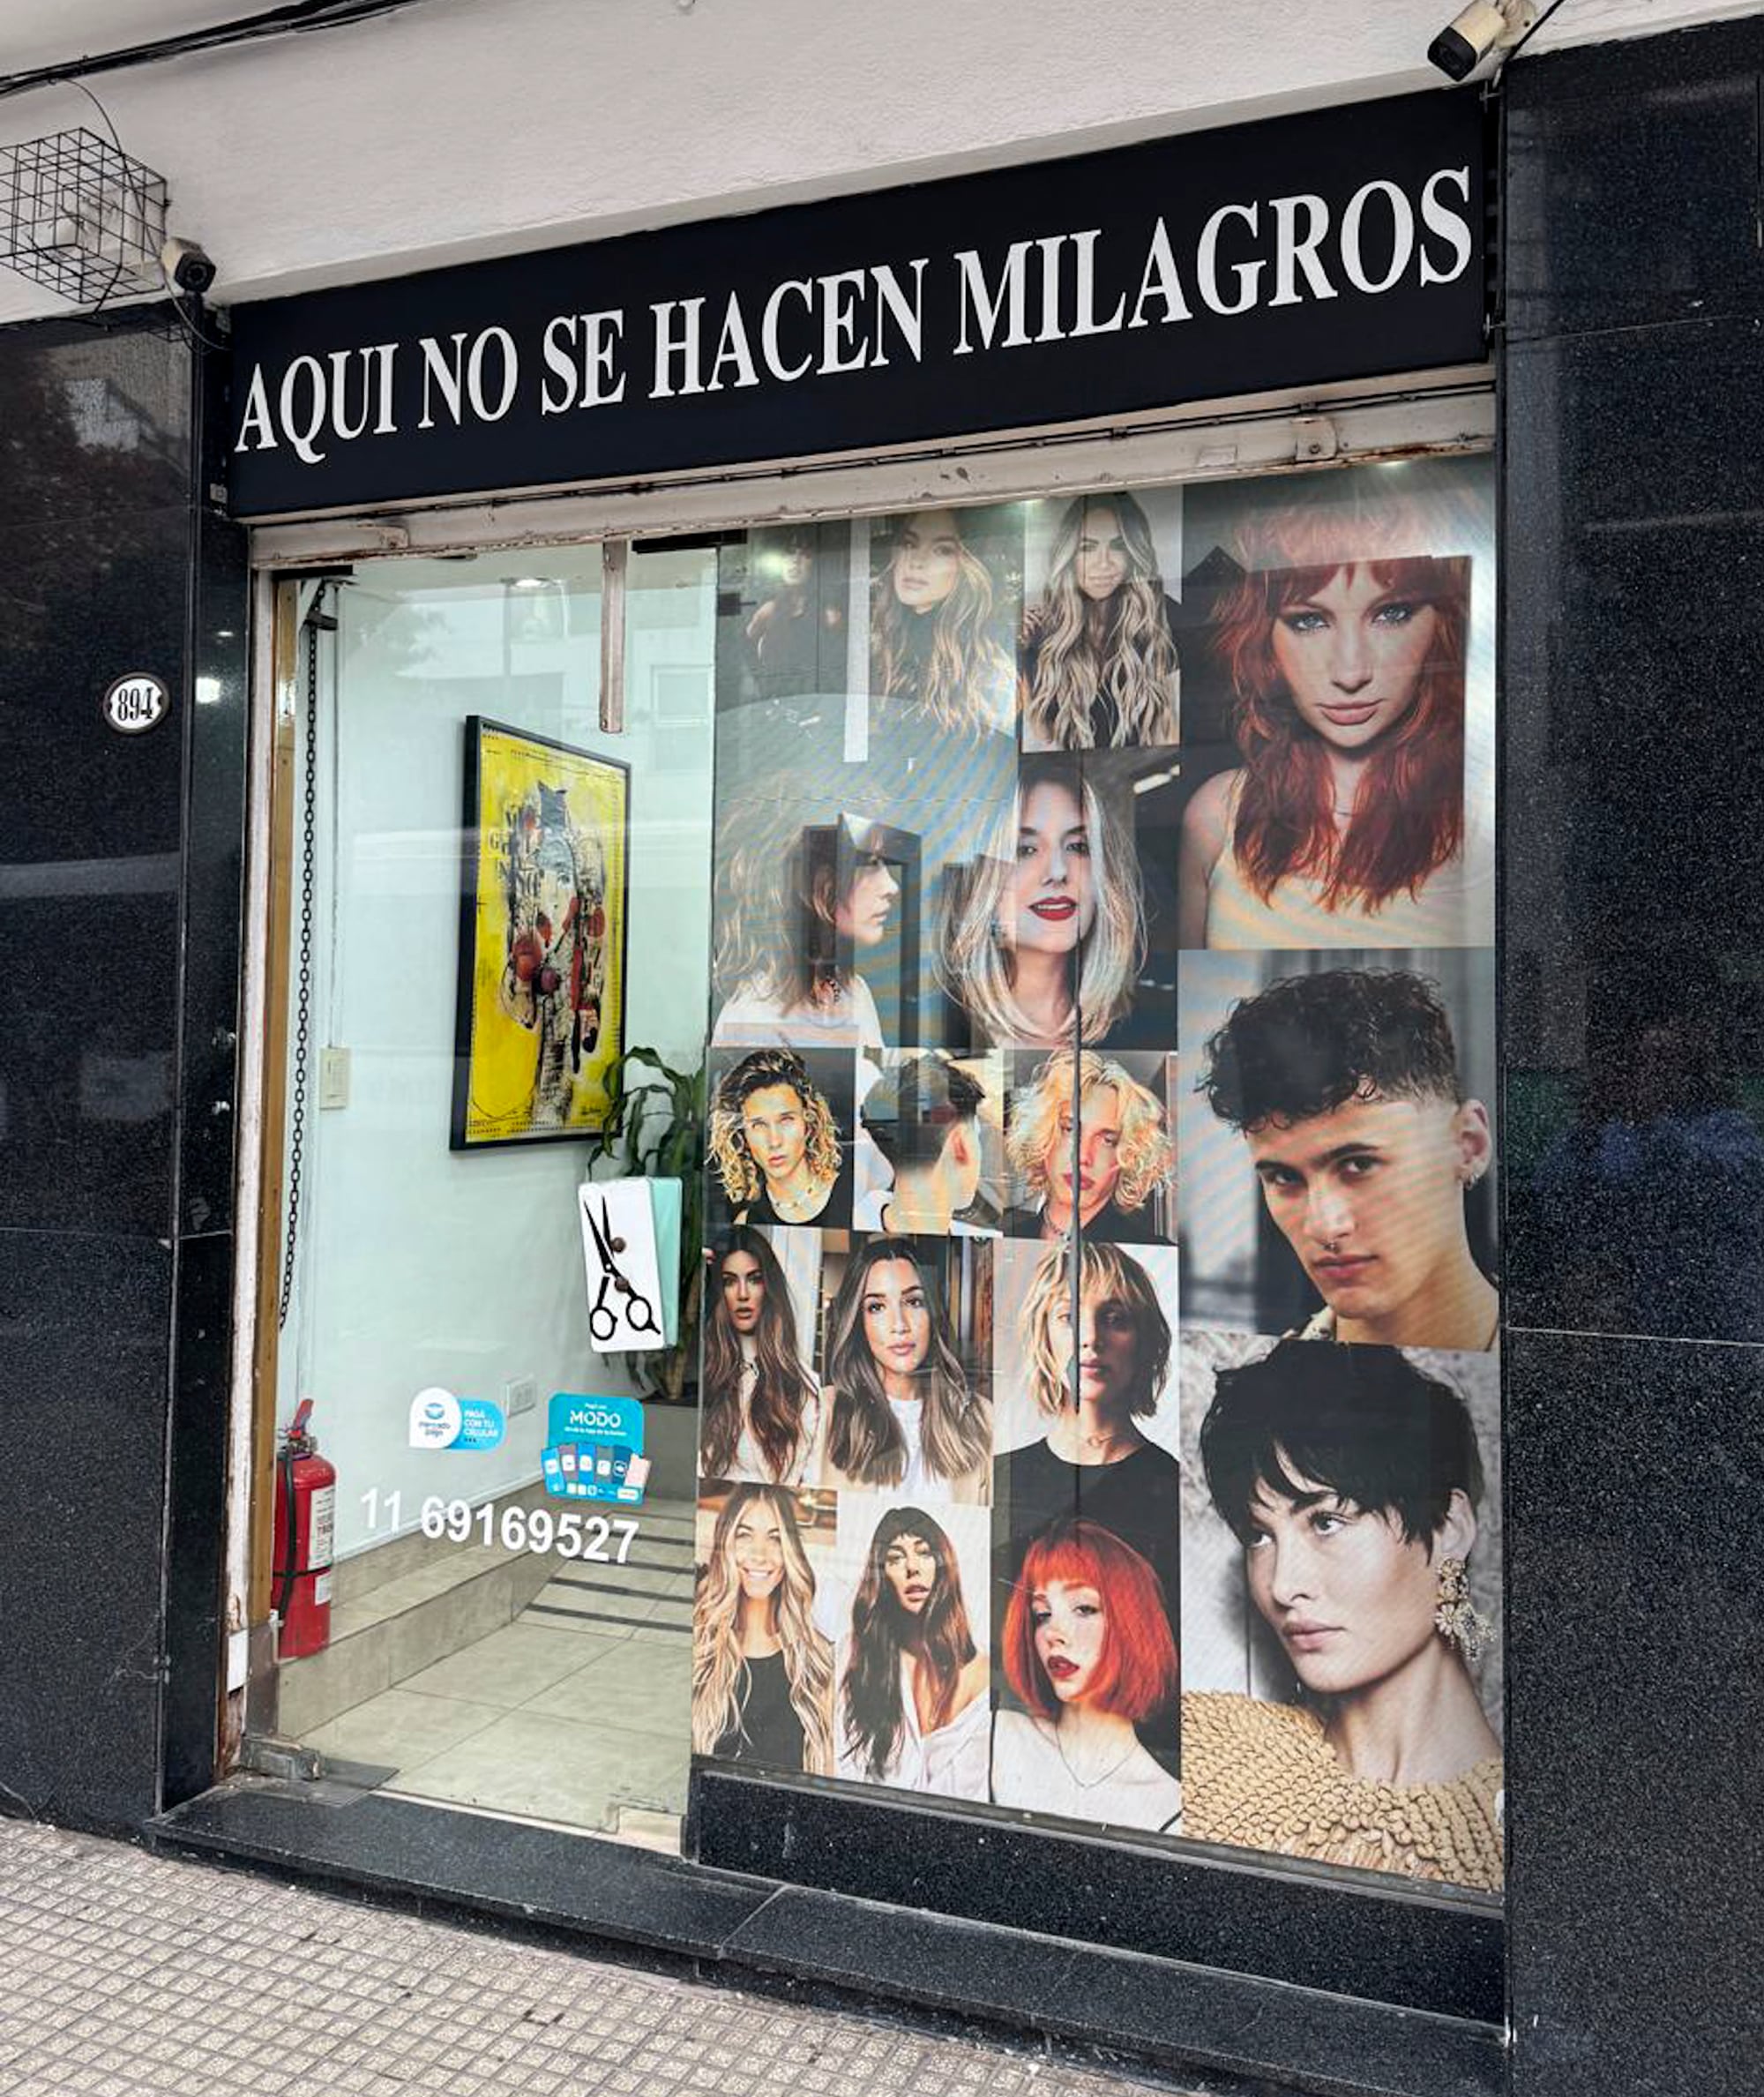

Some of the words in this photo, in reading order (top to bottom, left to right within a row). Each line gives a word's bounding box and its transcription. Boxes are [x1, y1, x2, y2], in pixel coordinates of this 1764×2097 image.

[235, 342, 400, 464] AQUI
[418, 326, 519, 429] NO
[542, 309, 626, 416] SE
[649, 258, 930, 399] HACEN
[953, 166, 1472, 355] MILAGROS
[117, 687, 153, 721] 894
[569, 1409, 621, 1428] MODO
[361, 1487, 400, 1533] 11
[421, 1495, 639, 1564] 69169527
